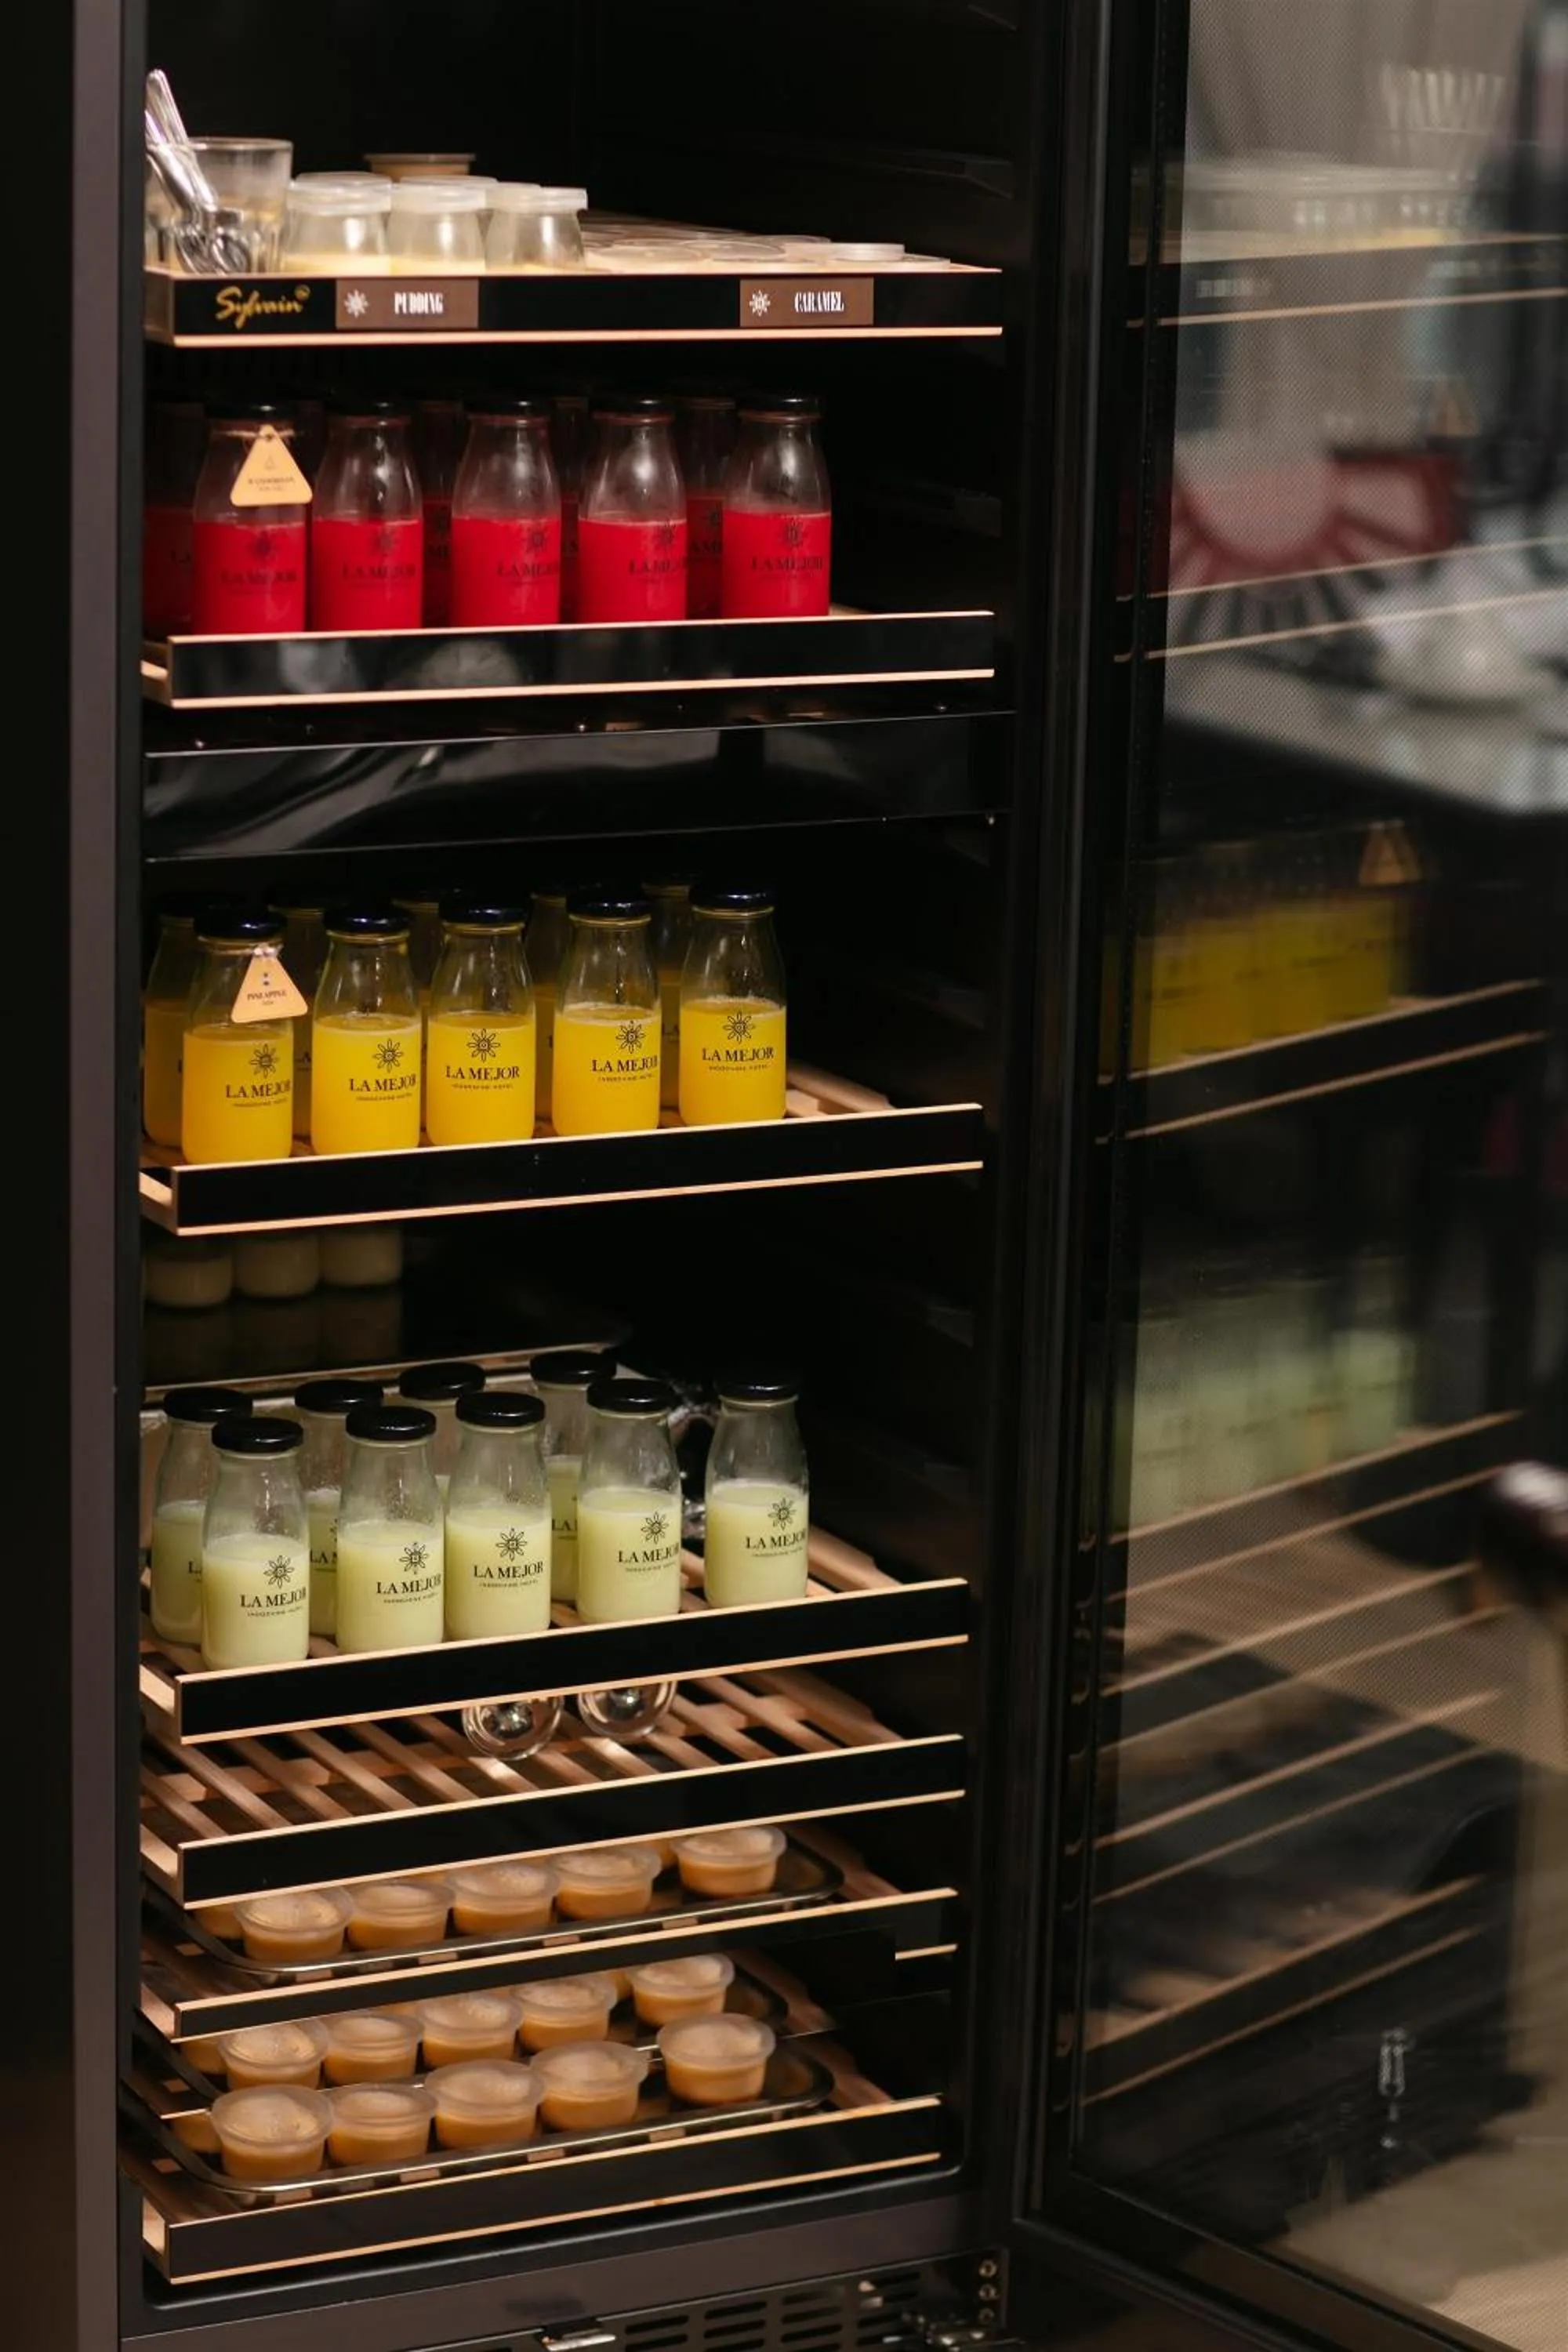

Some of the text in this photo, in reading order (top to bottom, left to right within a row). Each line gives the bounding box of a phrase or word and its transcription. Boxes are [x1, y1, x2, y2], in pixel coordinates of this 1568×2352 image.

[394, 292, 444, 314] PUDDING
[794, 291, 844, 313] CARAMEL
[702, 1047, 775, 1062] LA MEJOR
[445, 1065, 520, 1080] LA MEJOR
[592, 1060, 613, 1073] LA
[226, 1079, 291, 1098] LA MEJOR
[350, 1074, 416, 1092] LA MEJOR
[746, 1537, 766, 1549] LA
[619, 1550, 639, 1563] LA
[474, 1561, 544, 1579] LA MEJOR
[376, 1573, 441, 1595] LA MEJOR
[240, 1586, 307, 1609] LA MEJOR
